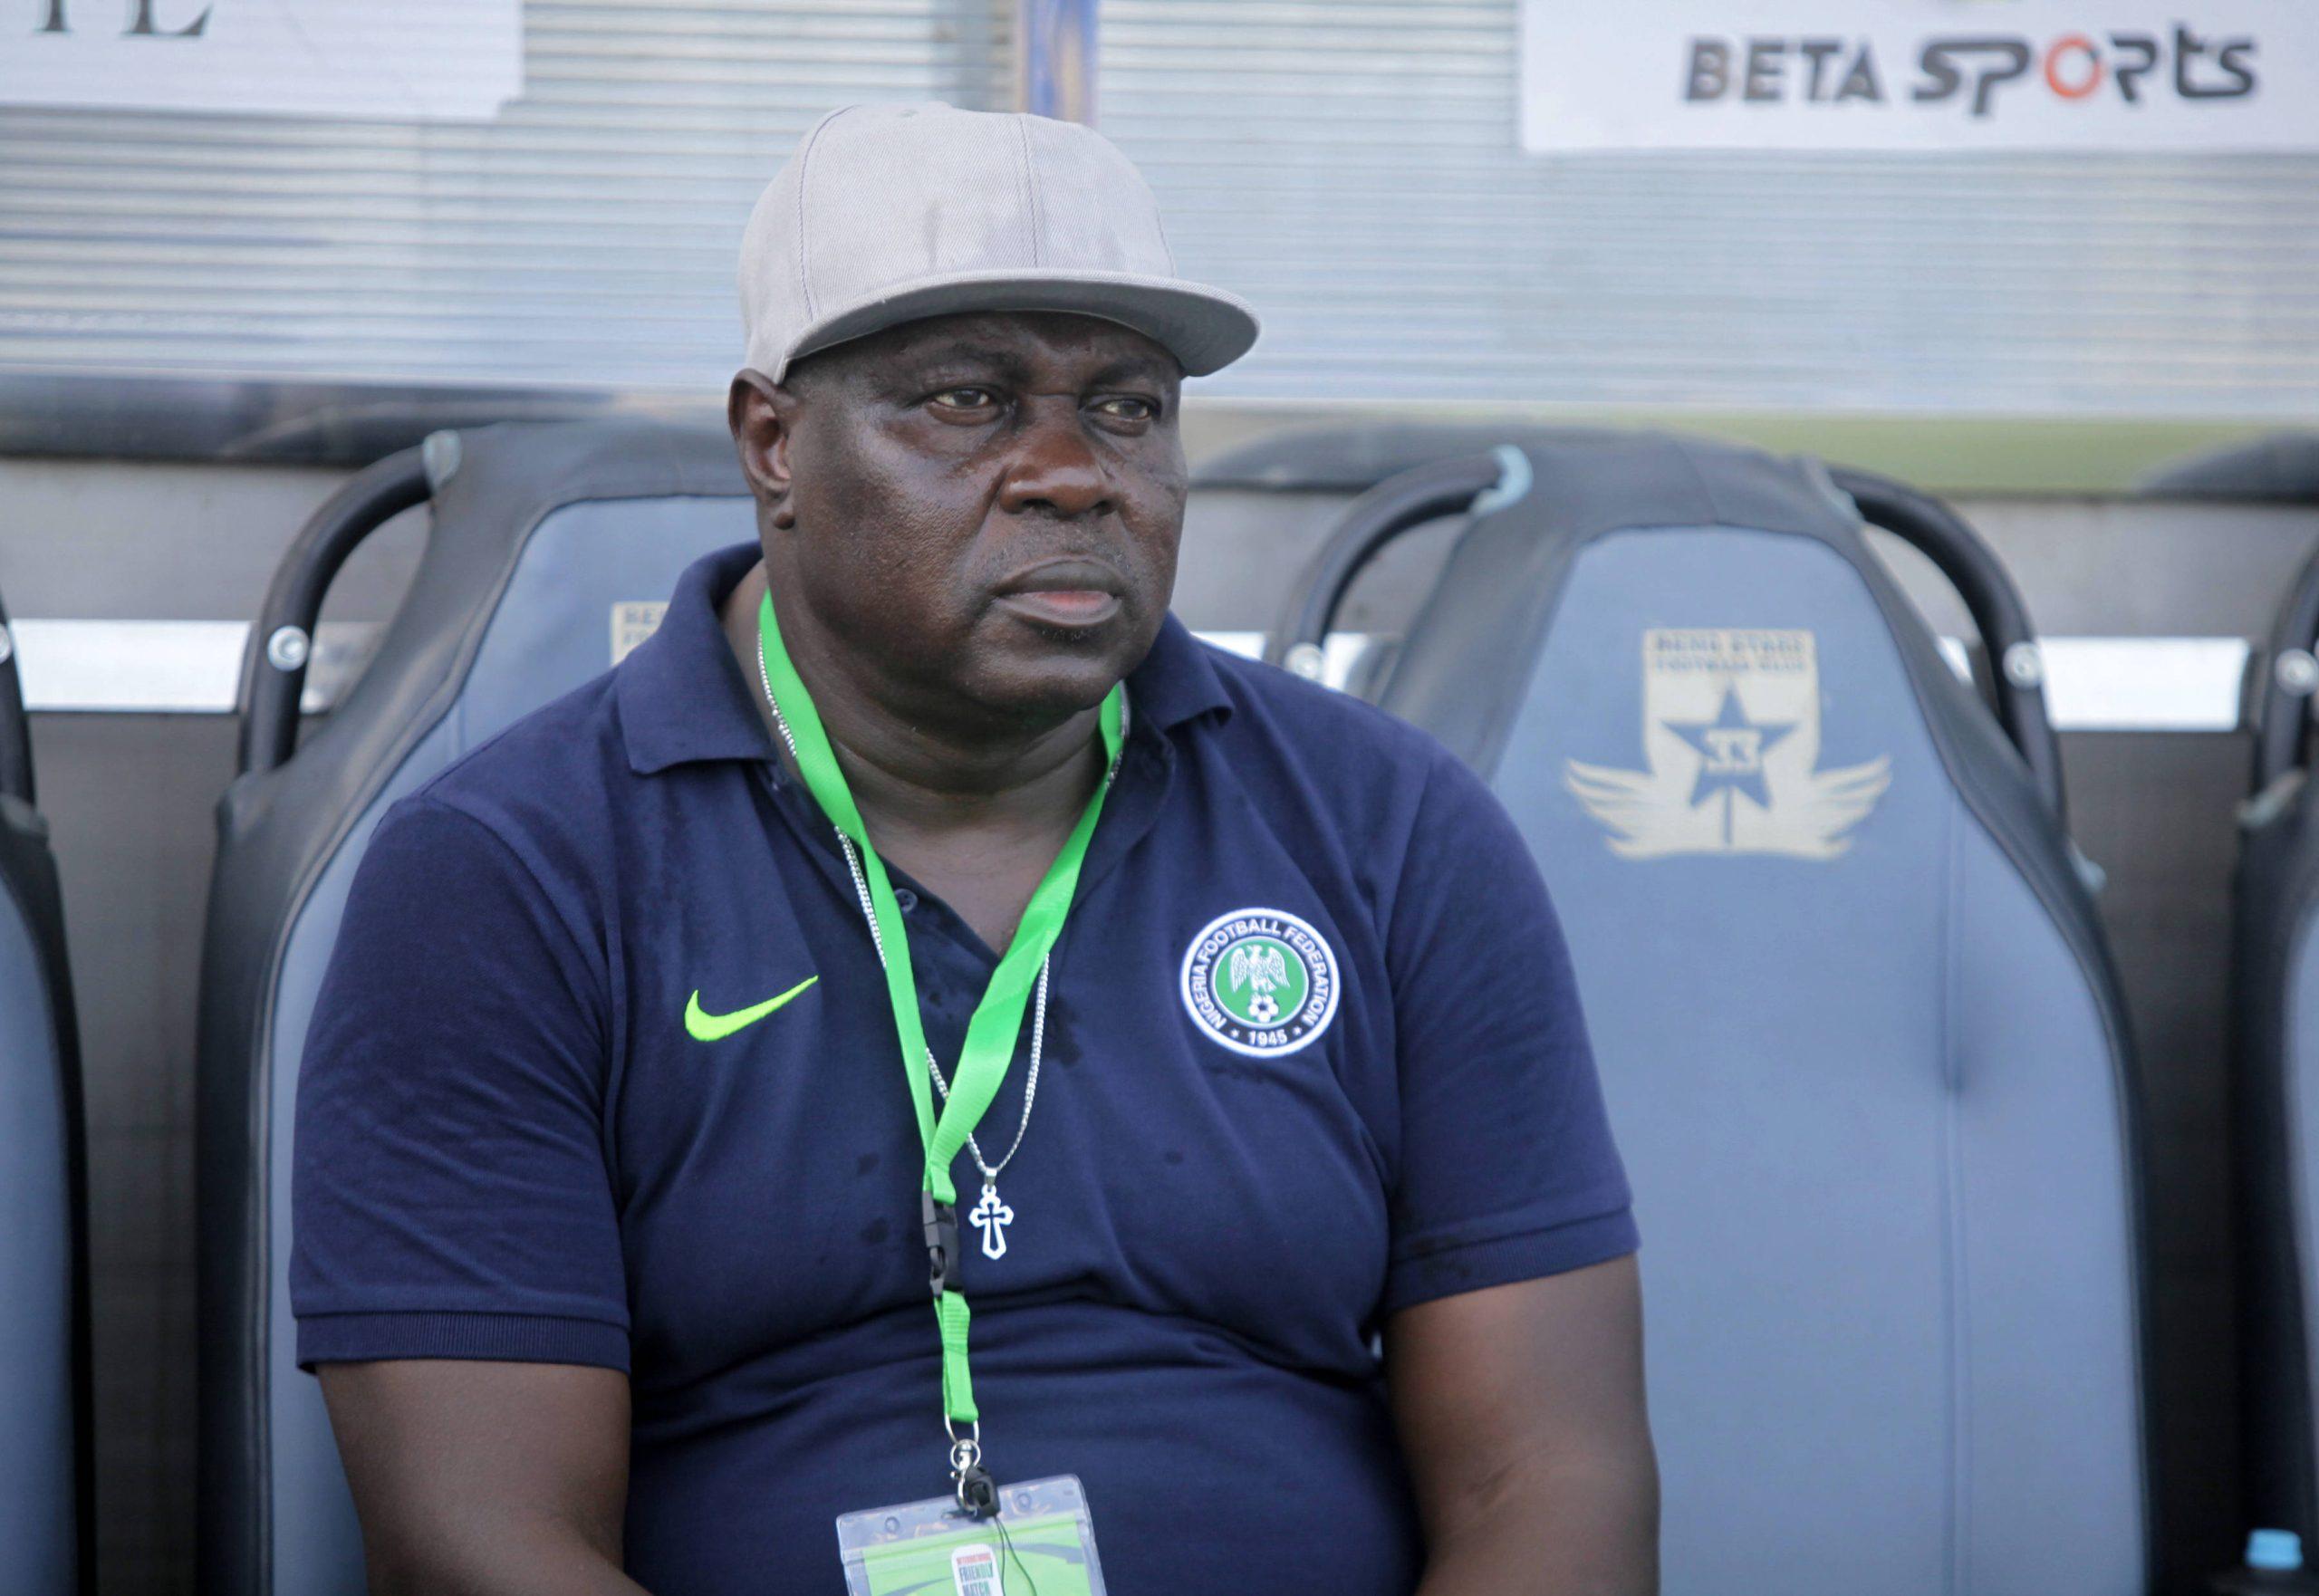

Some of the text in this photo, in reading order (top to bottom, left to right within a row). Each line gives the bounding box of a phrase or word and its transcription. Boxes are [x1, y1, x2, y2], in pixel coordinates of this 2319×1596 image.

[1685, 38, 1886, 102] BETA
[1191, 918, 1329, 1030] NIGERIA FOOTBALL FEDERATION
[1248, 1029, 1288, 1047] 1945
